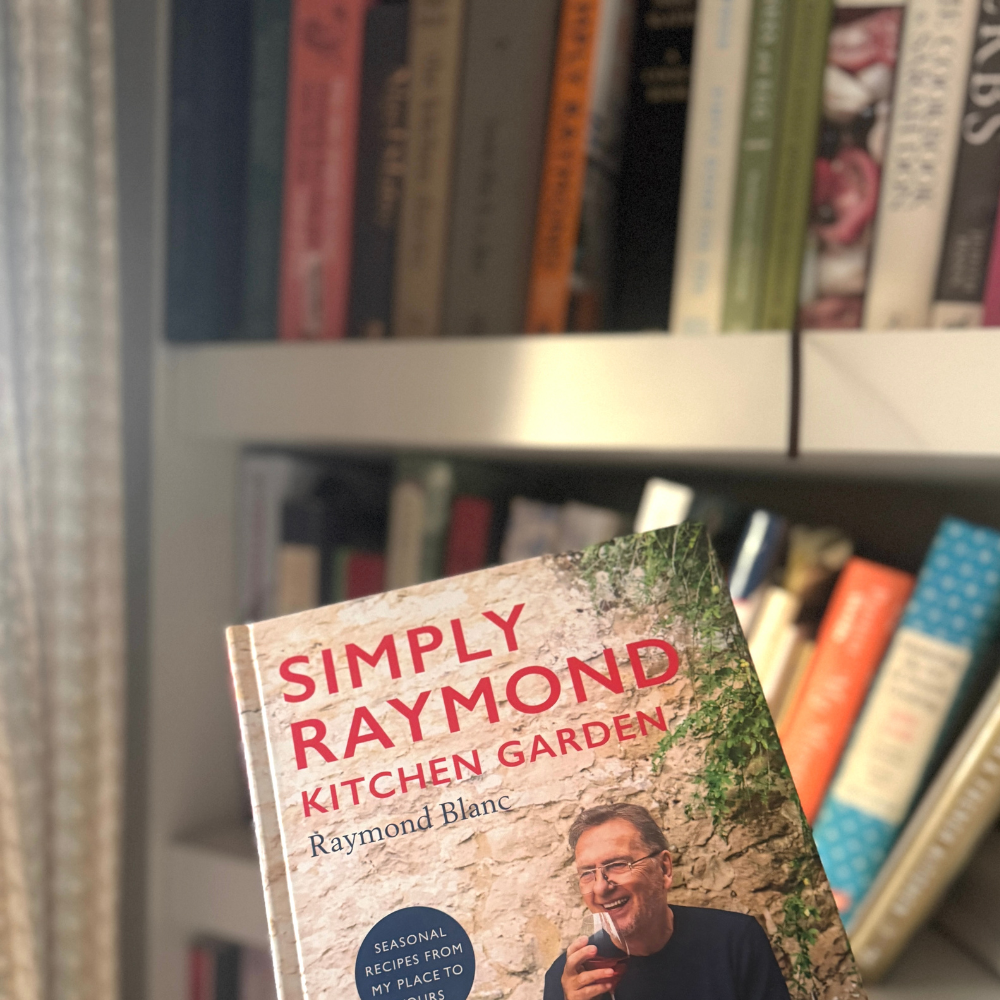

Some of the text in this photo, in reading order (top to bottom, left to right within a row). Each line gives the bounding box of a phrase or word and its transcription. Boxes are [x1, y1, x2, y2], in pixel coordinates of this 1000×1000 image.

[278, 603, 525, 703] SIMPLY
[290, 638, 680, 770] RAYMOND
[301, 706, 668, 818] KITCHEN GARDEN
[308, 794, 513, 858] Raymond Blanc
[365, 943, 463, 977] RECIPES FROM
[374, 927, 447, 954] SEASONAL
[371, 964, 463, 997] MY PLACE TO
